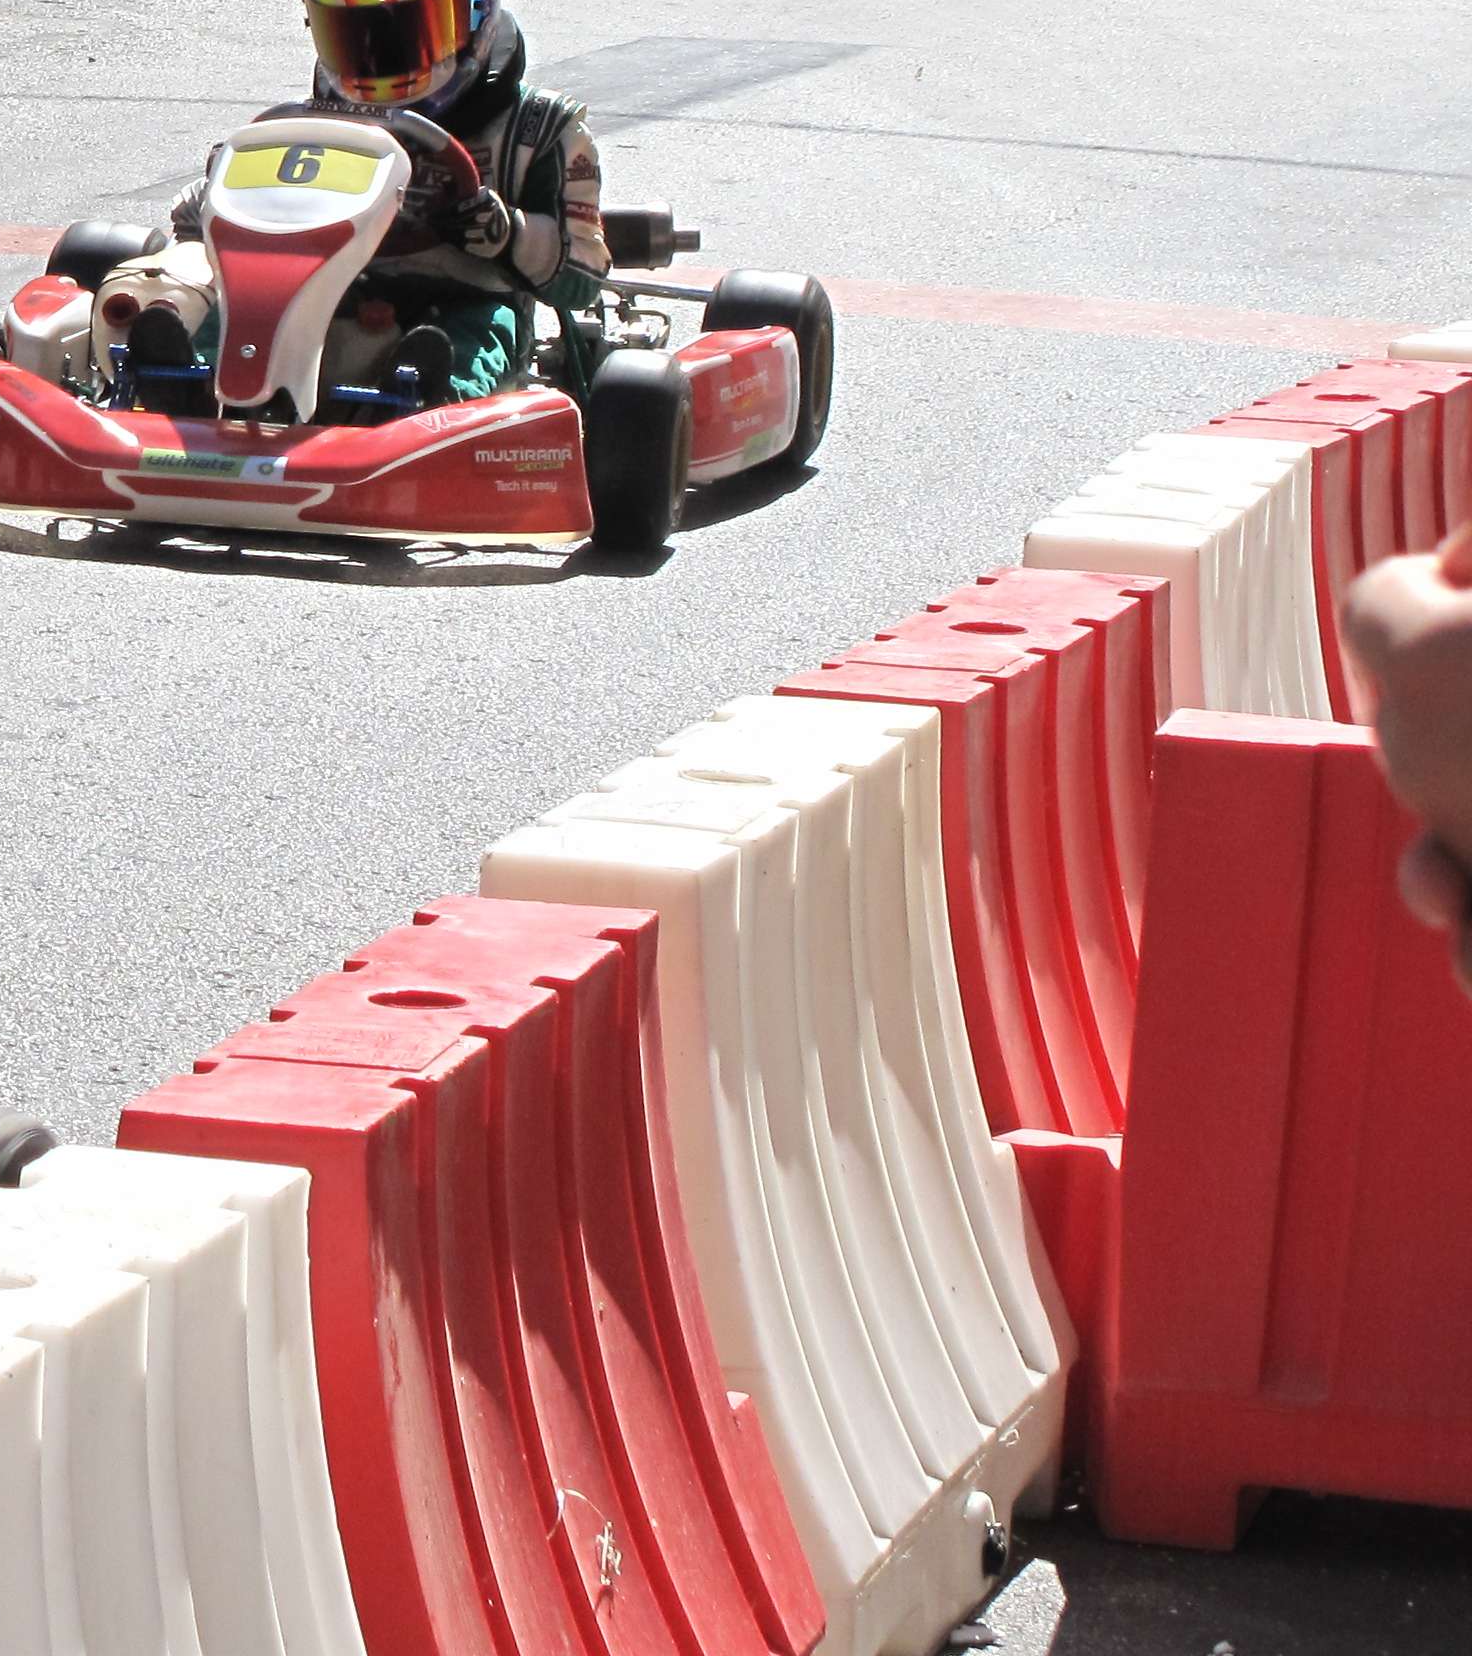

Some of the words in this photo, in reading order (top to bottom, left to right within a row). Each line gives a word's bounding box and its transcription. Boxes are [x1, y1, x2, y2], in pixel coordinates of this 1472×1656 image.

[278, 144, 325, 185] 6
[146, 454, 236, 472] ultimate
[475, 447, 573, 463] MULTIRAMA
